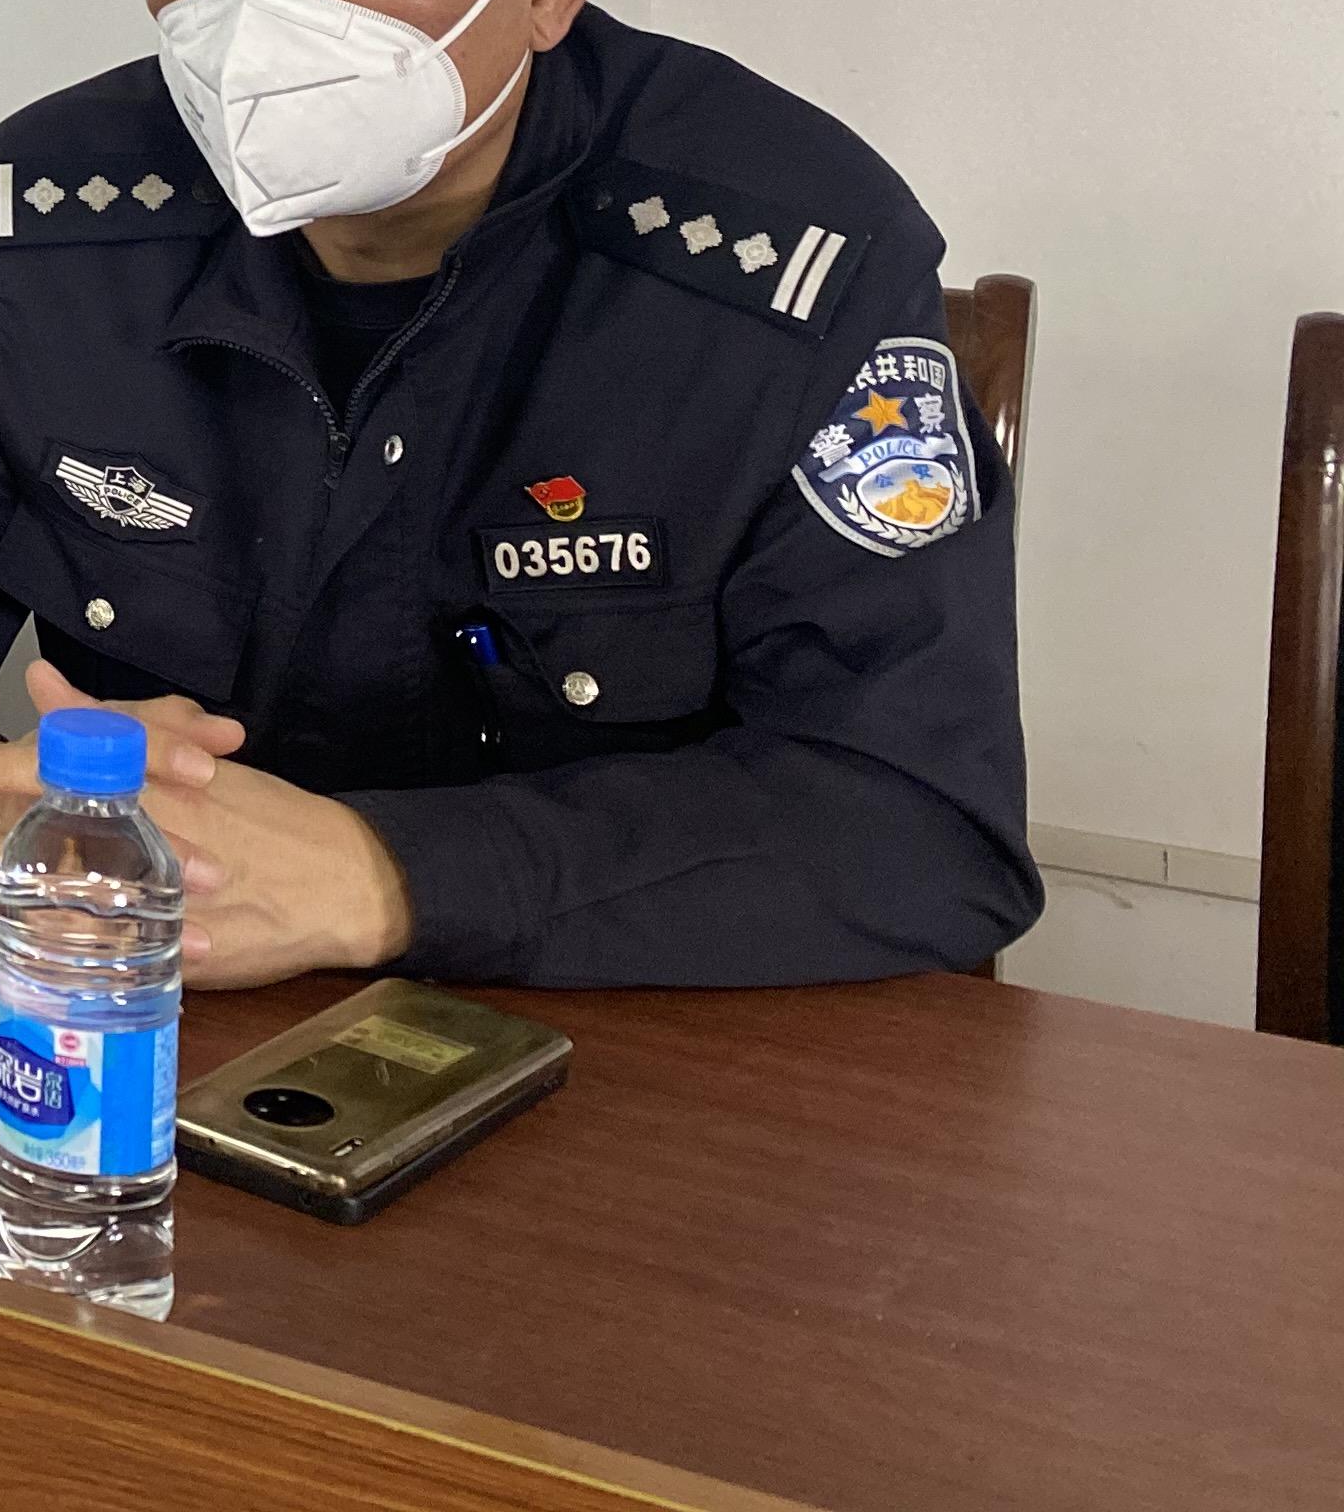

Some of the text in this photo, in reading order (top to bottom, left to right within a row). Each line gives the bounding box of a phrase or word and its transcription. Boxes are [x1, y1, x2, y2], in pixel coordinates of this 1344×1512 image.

[858, 441, 923, 470] POLICE
[104, 486, 143, 506] POLICE
[495, 533, 651, 579] 035676
